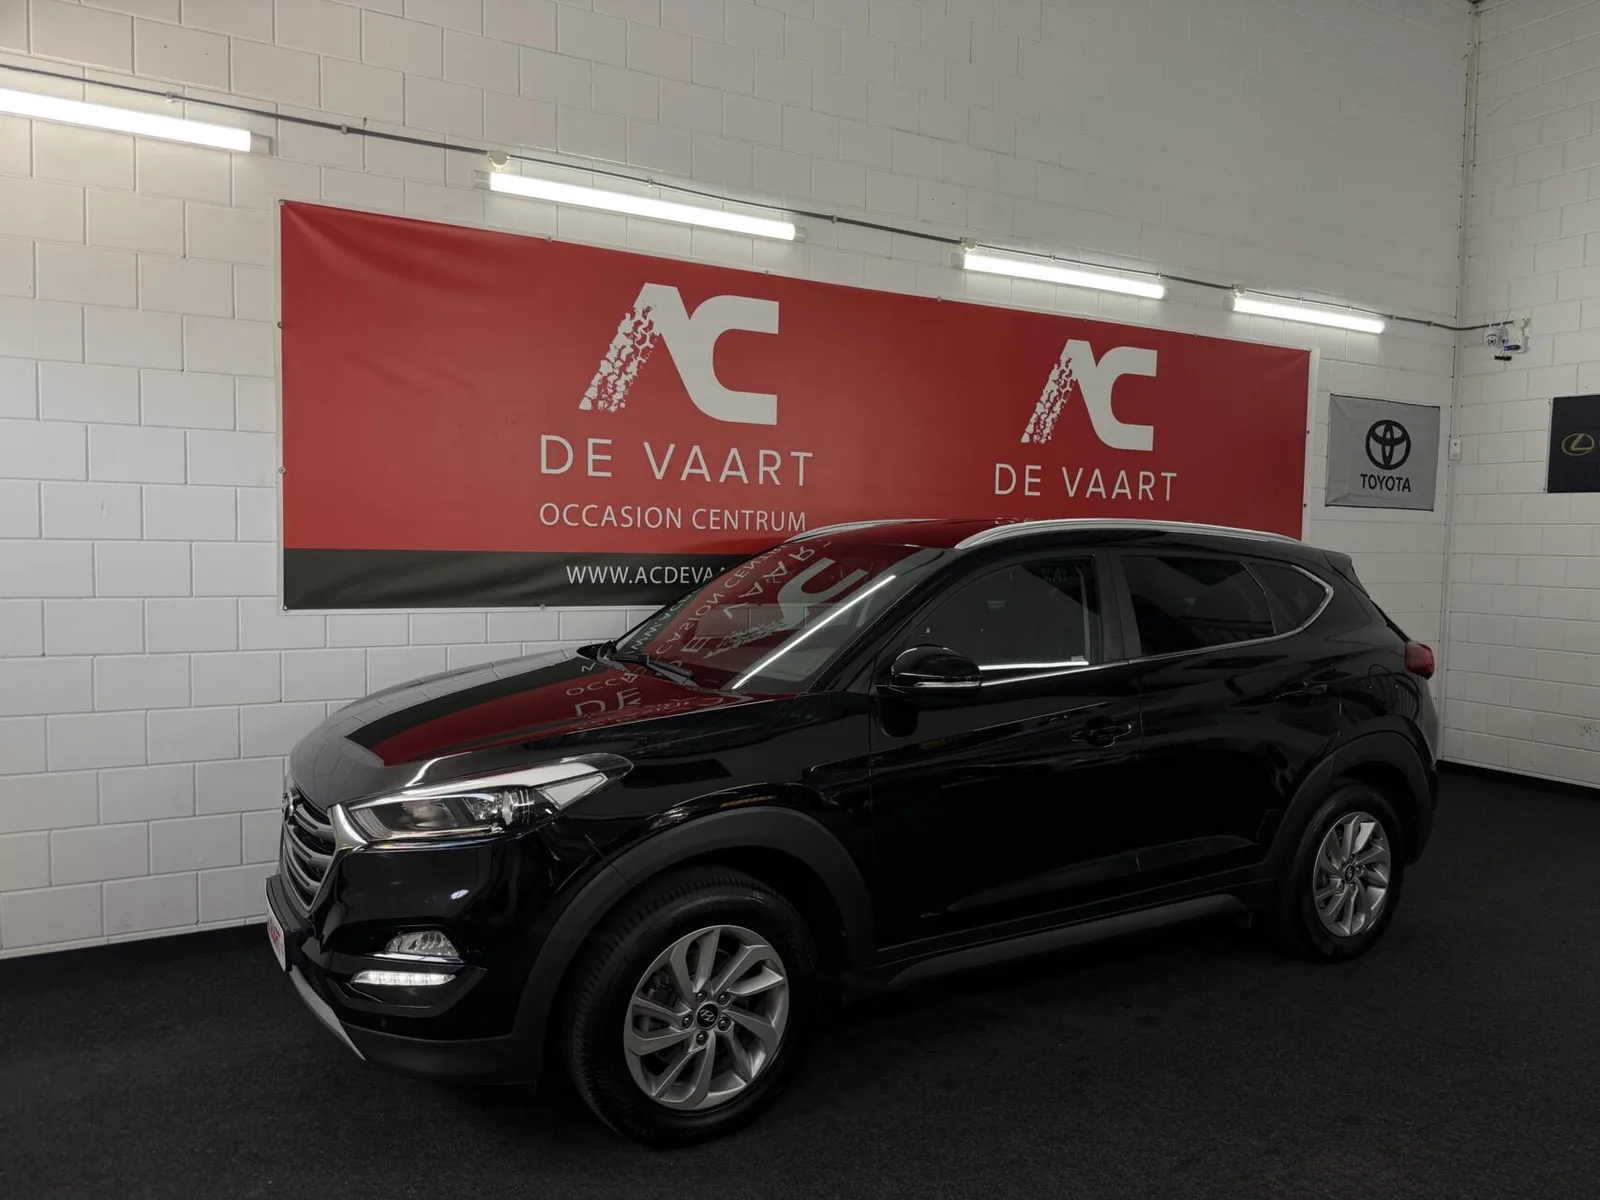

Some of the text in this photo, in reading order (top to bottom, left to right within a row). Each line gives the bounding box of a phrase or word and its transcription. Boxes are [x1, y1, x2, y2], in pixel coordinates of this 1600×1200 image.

[540, 434, 813, 486] DE VAART
[994, 462, 1177, 501] DE VAART
[1360, 473, 1411, 493] TOYOTA
[539, 502, 807, 532] OCCASION CENTRUM
[566, 565, 726, 584] WWW.ACDEVA
